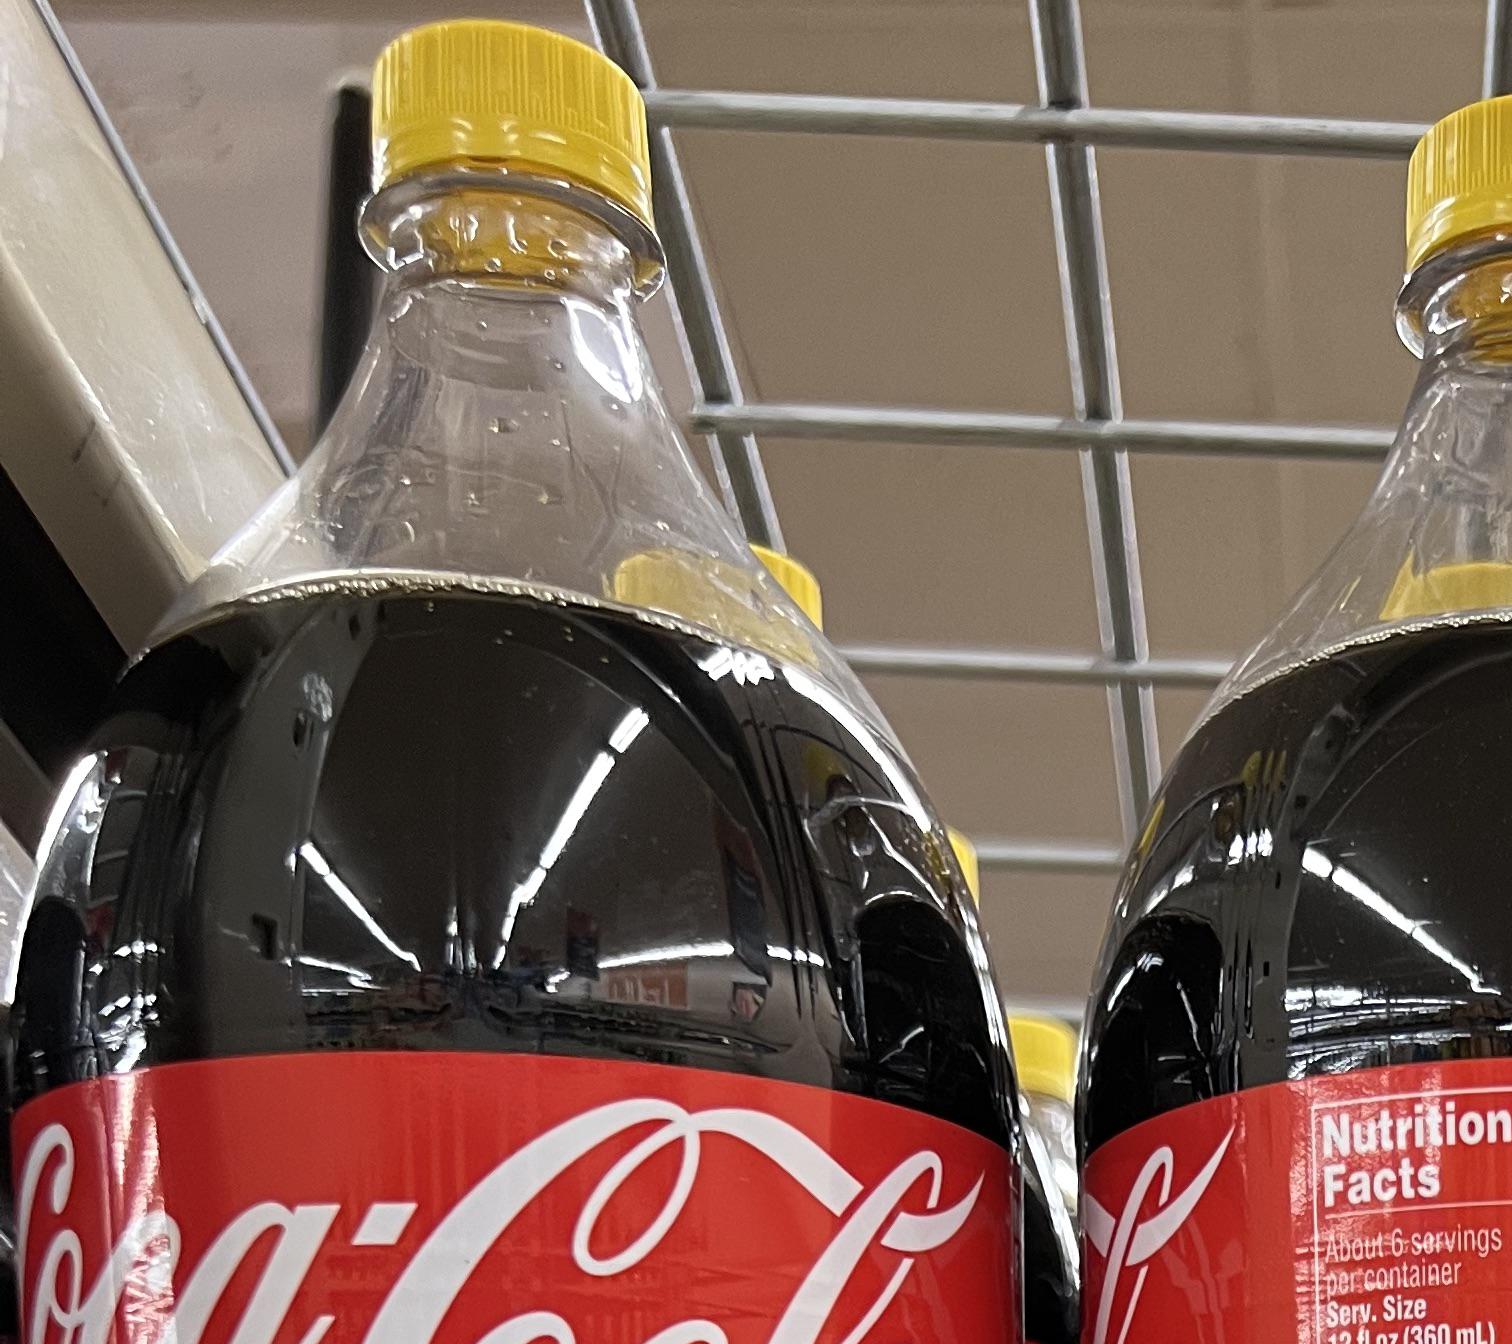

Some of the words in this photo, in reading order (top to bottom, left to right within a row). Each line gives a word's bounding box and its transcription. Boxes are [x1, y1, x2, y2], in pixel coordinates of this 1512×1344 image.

[1321, 1100, 1512, 1158] Nutrition
[1324, 1157, 1441, 1208] Facts
[1325, 1231, 1384, 1264] About
[1411, 1223, 1503, 1259] servings
[1326, 1272, 1359, 1301] per
[1363, 1257, 1463, 1292] container
[1326, 1300, 1377, 1329] Serv.
[1383, 1294, 1428, 1322] Size
